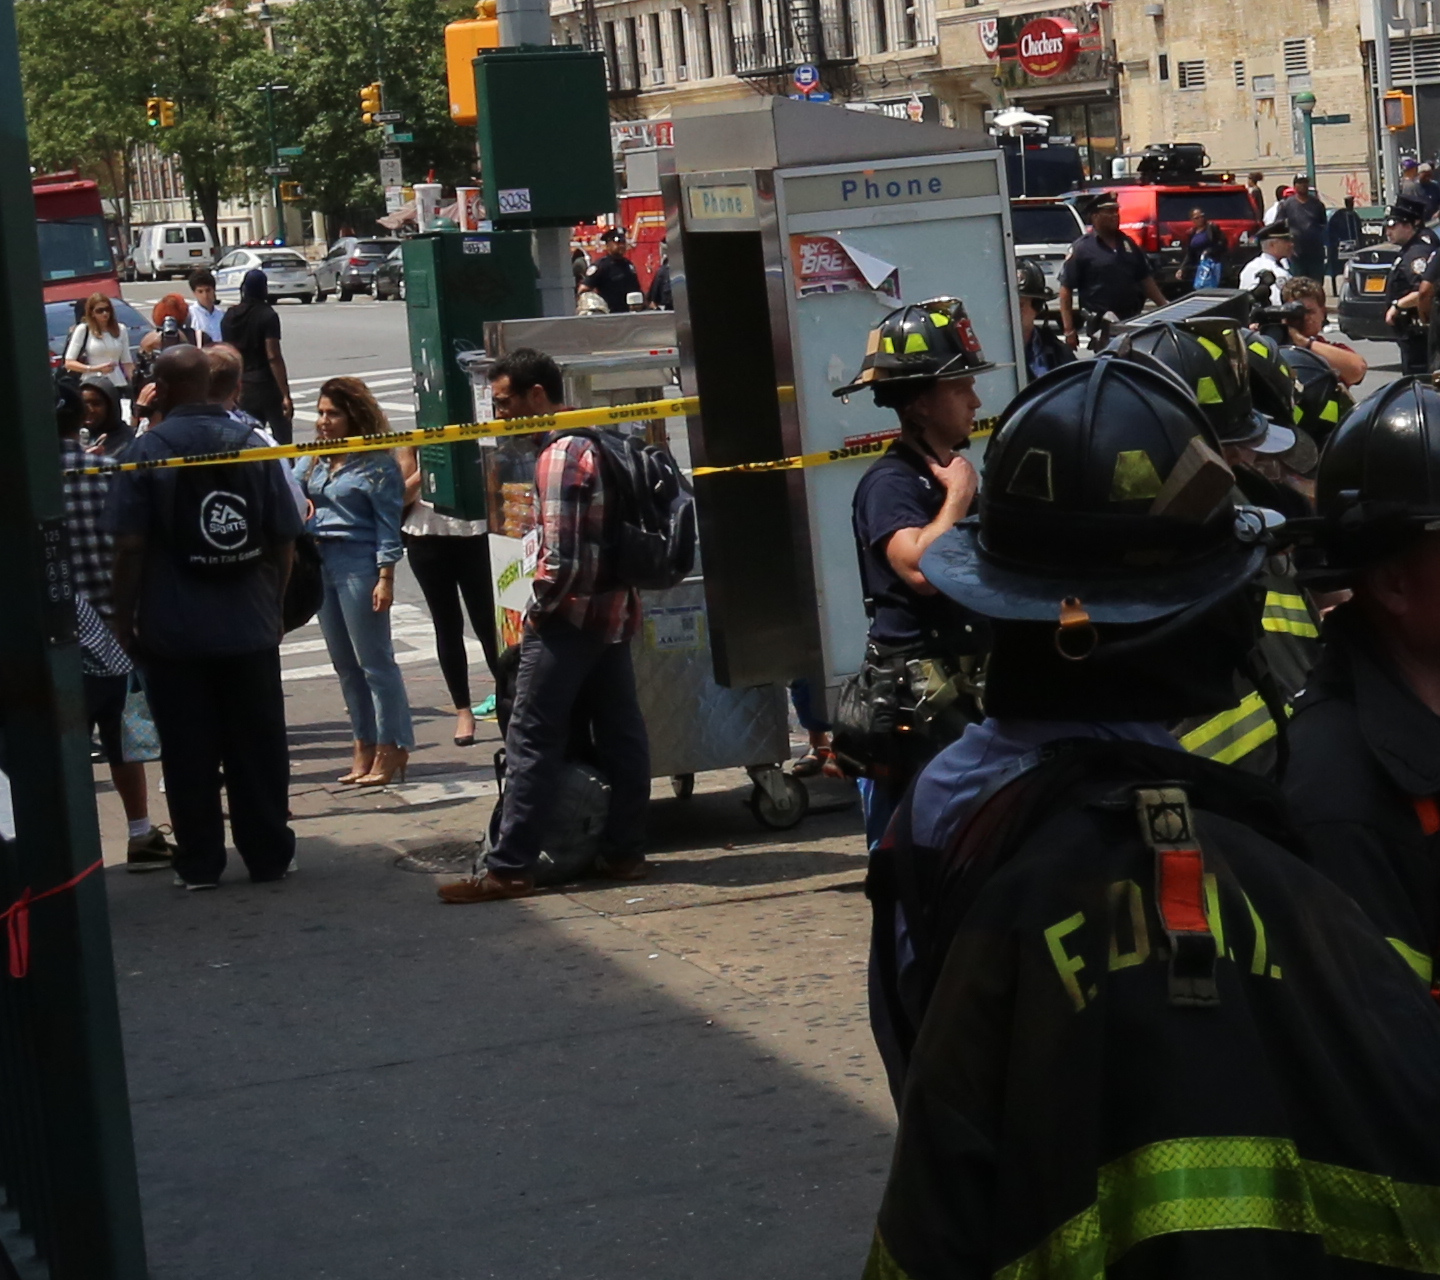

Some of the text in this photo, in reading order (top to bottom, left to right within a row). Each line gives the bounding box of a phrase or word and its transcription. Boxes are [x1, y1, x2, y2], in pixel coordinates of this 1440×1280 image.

[1020, 31, 1064, 58] Checkers
[840, 176, 943, 202] Phone
[703, 192, 743, 214] Phone
[209, 502, 244, 525] EA
[43, 529, 60, 543] 125
[209, 519, 247, 535] SPORTS
[44, 545, 57, 560] ST
